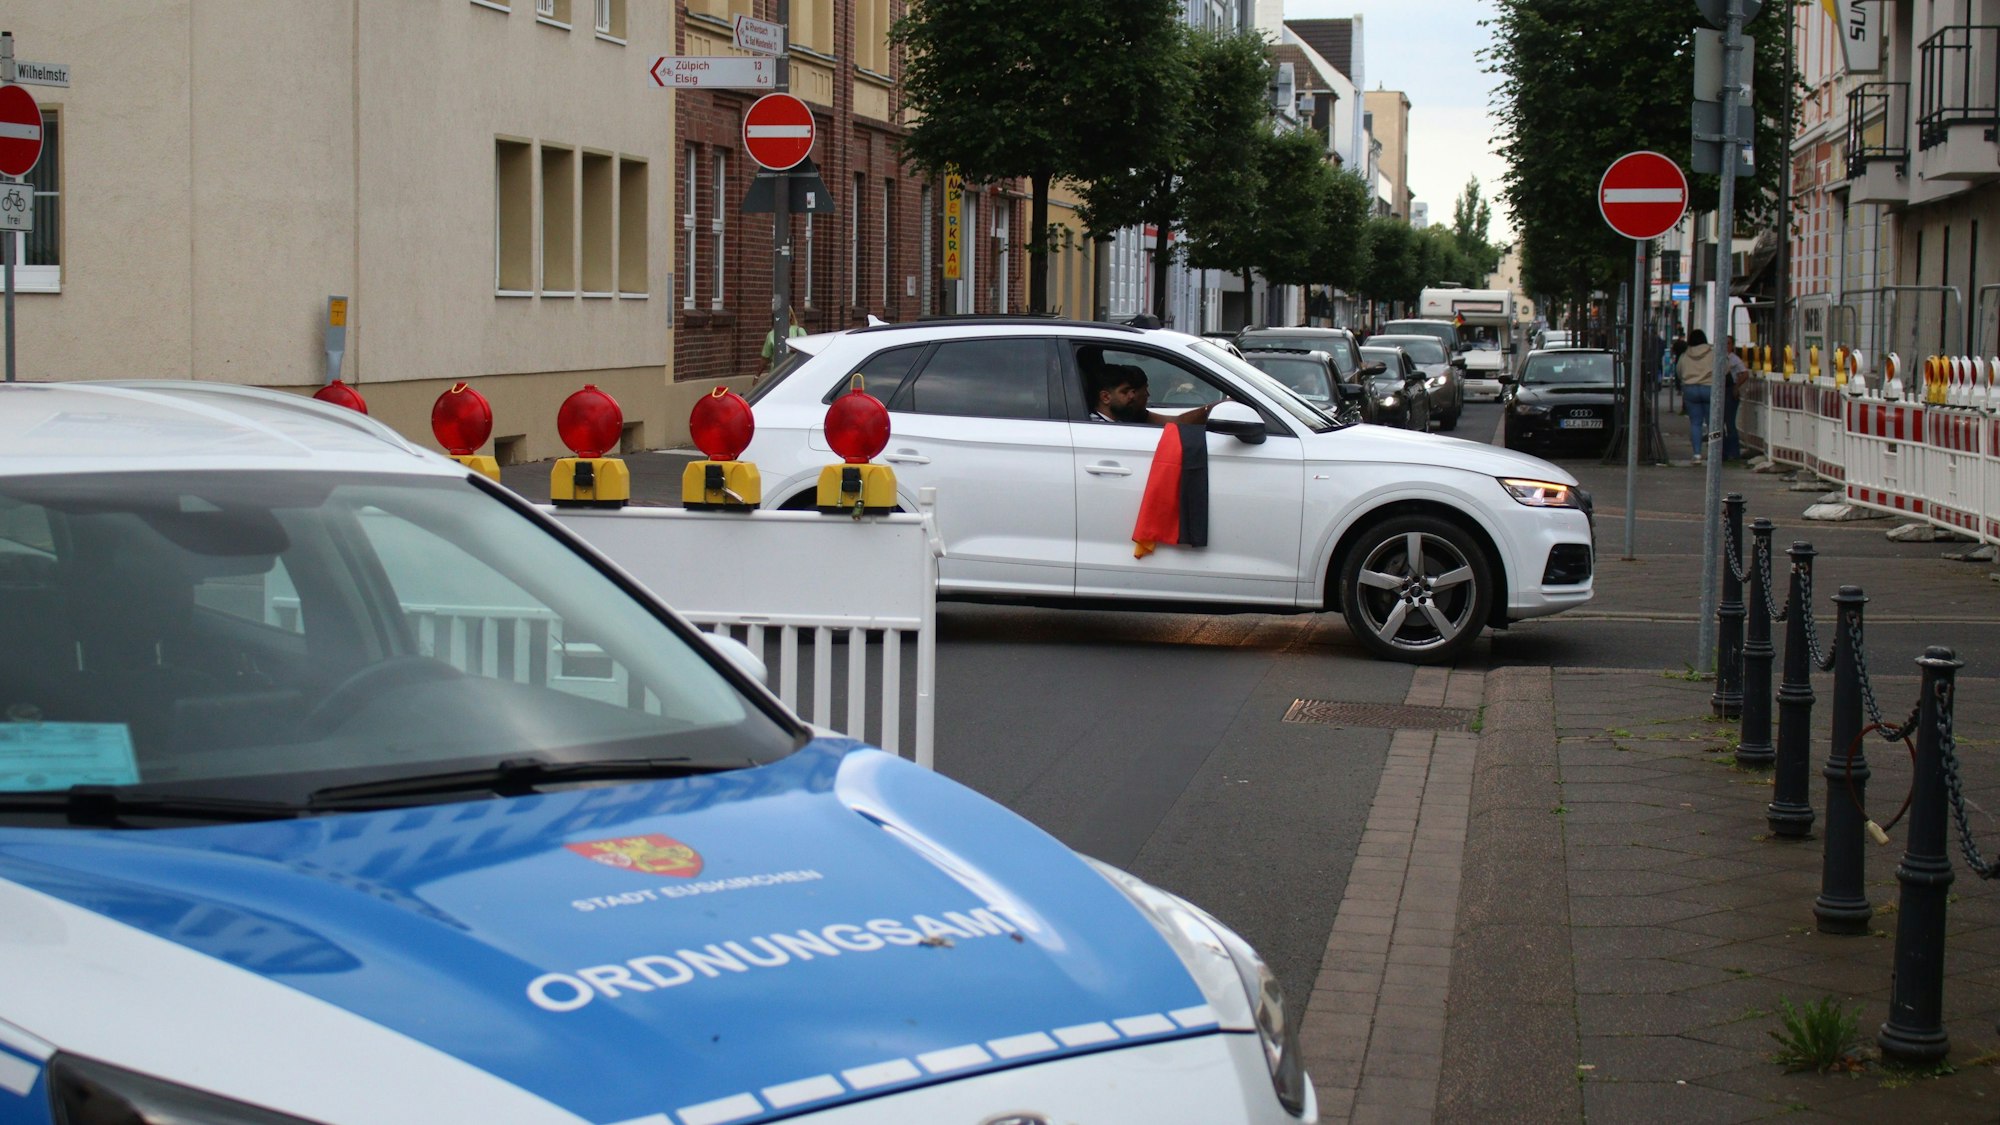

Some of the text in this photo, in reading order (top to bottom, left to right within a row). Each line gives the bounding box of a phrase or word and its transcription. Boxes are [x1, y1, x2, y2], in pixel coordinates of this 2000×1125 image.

[18, 63, 68, 82] Wilhelmstr.
[675, 60, 762, 71] Zülpich 13
[675, 74, 698, 85] Elsig
[7, 214, 21, 225] frei
[946, 162, 959, 277] NDERKRAM
[571, 869, 824, 912] STADT EUSKIRCHEN
[526, 904, 1030, 1012] ORDNUNGSAMT
